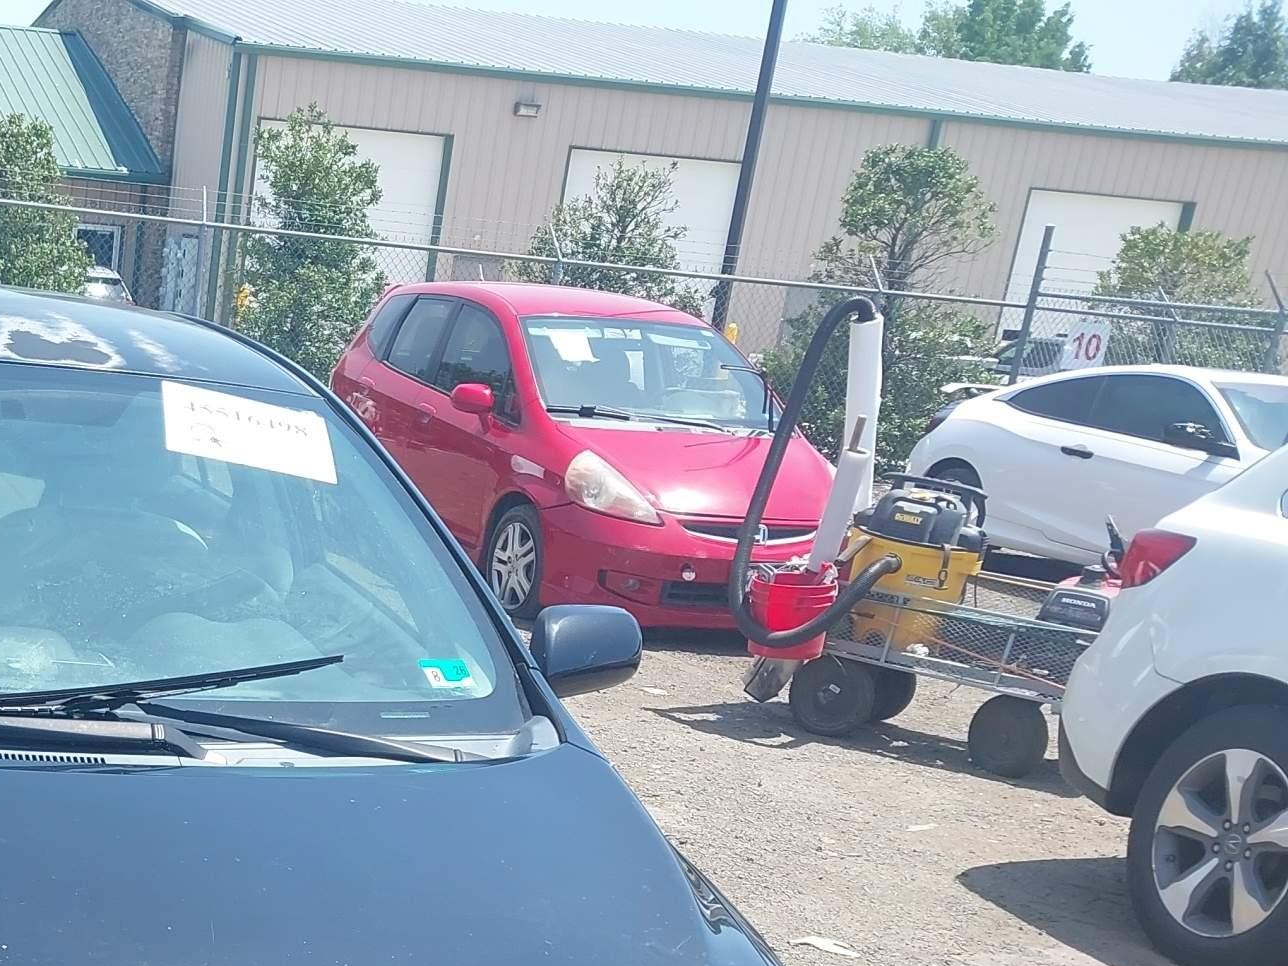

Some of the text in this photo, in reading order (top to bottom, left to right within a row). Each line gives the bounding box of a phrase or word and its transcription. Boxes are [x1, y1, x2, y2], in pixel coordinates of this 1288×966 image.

[1073, 332, 1102, 361] 10
[1061, 597, 1096, 609] HONDA
[431, 670, 441, 682] 8
